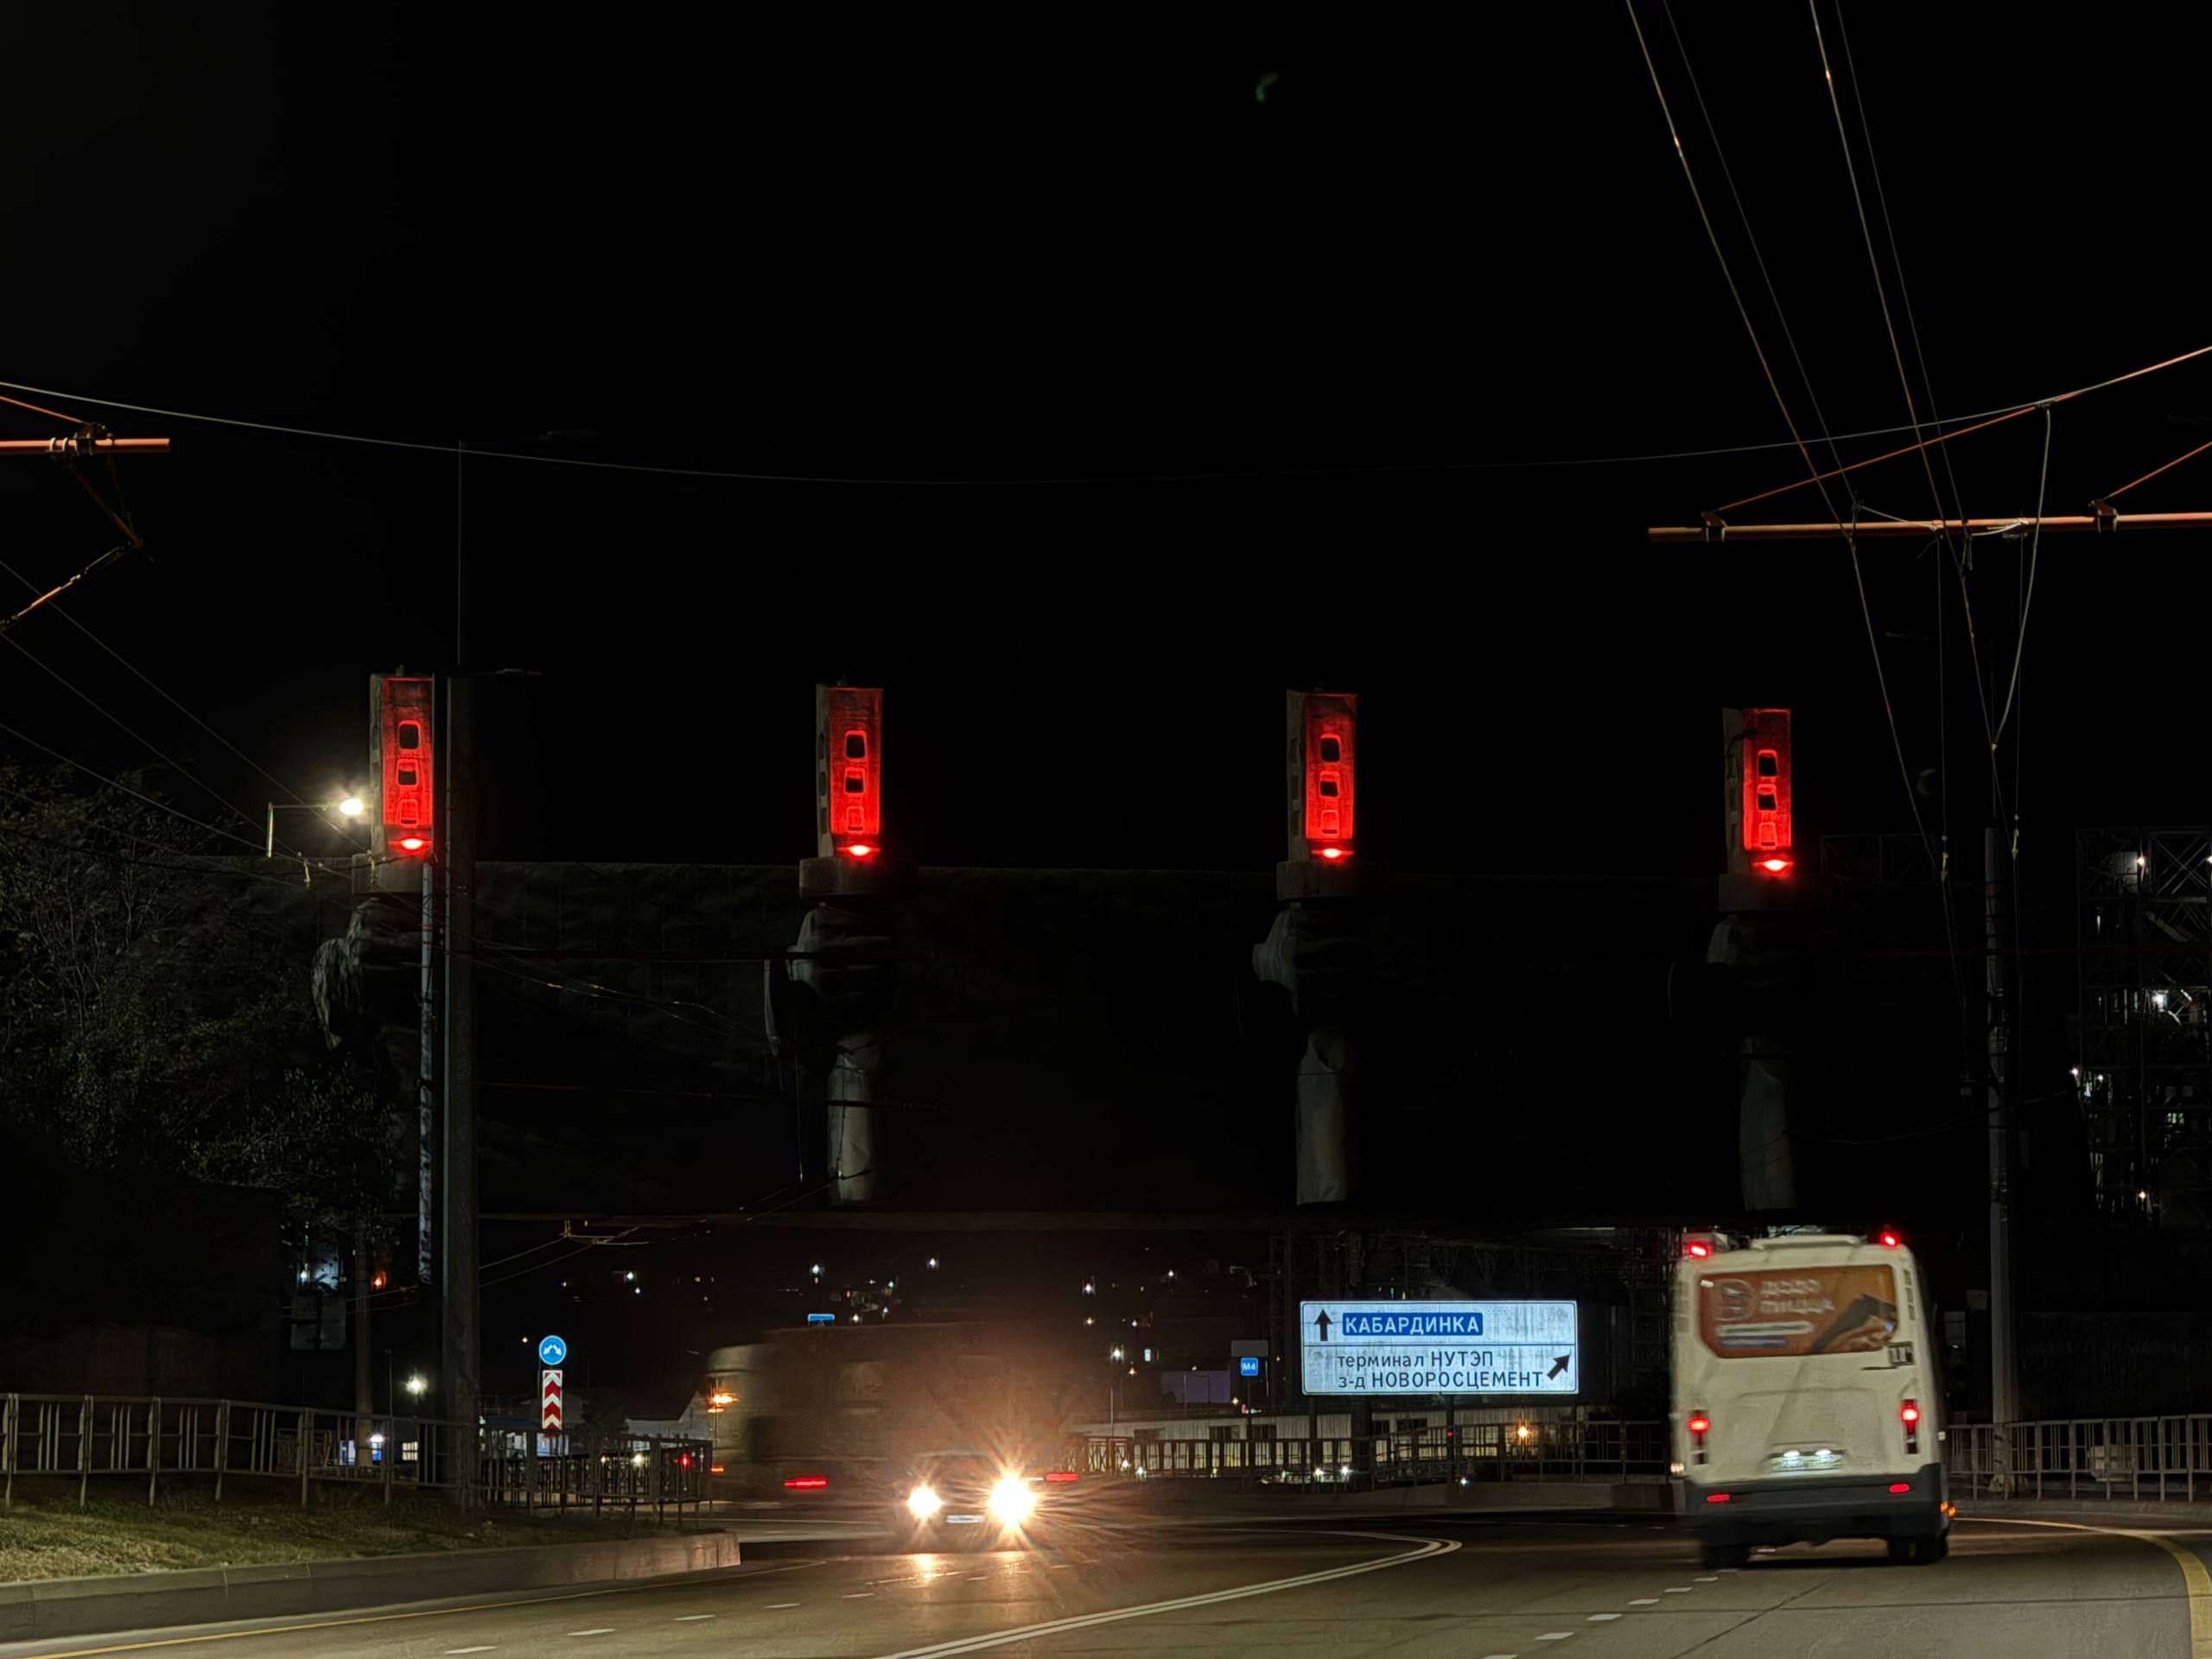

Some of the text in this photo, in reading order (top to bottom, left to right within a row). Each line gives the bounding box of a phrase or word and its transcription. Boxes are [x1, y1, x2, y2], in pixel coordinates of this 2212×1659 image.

[1345, 1316, 1480, 1335] КАБАРДИНКА
[1337, 1351, 1493, 1371] терминал НУТЭП
[1338, 1371, 1543, 1389] з-д НОВОРОСЦЕМЕНТ
